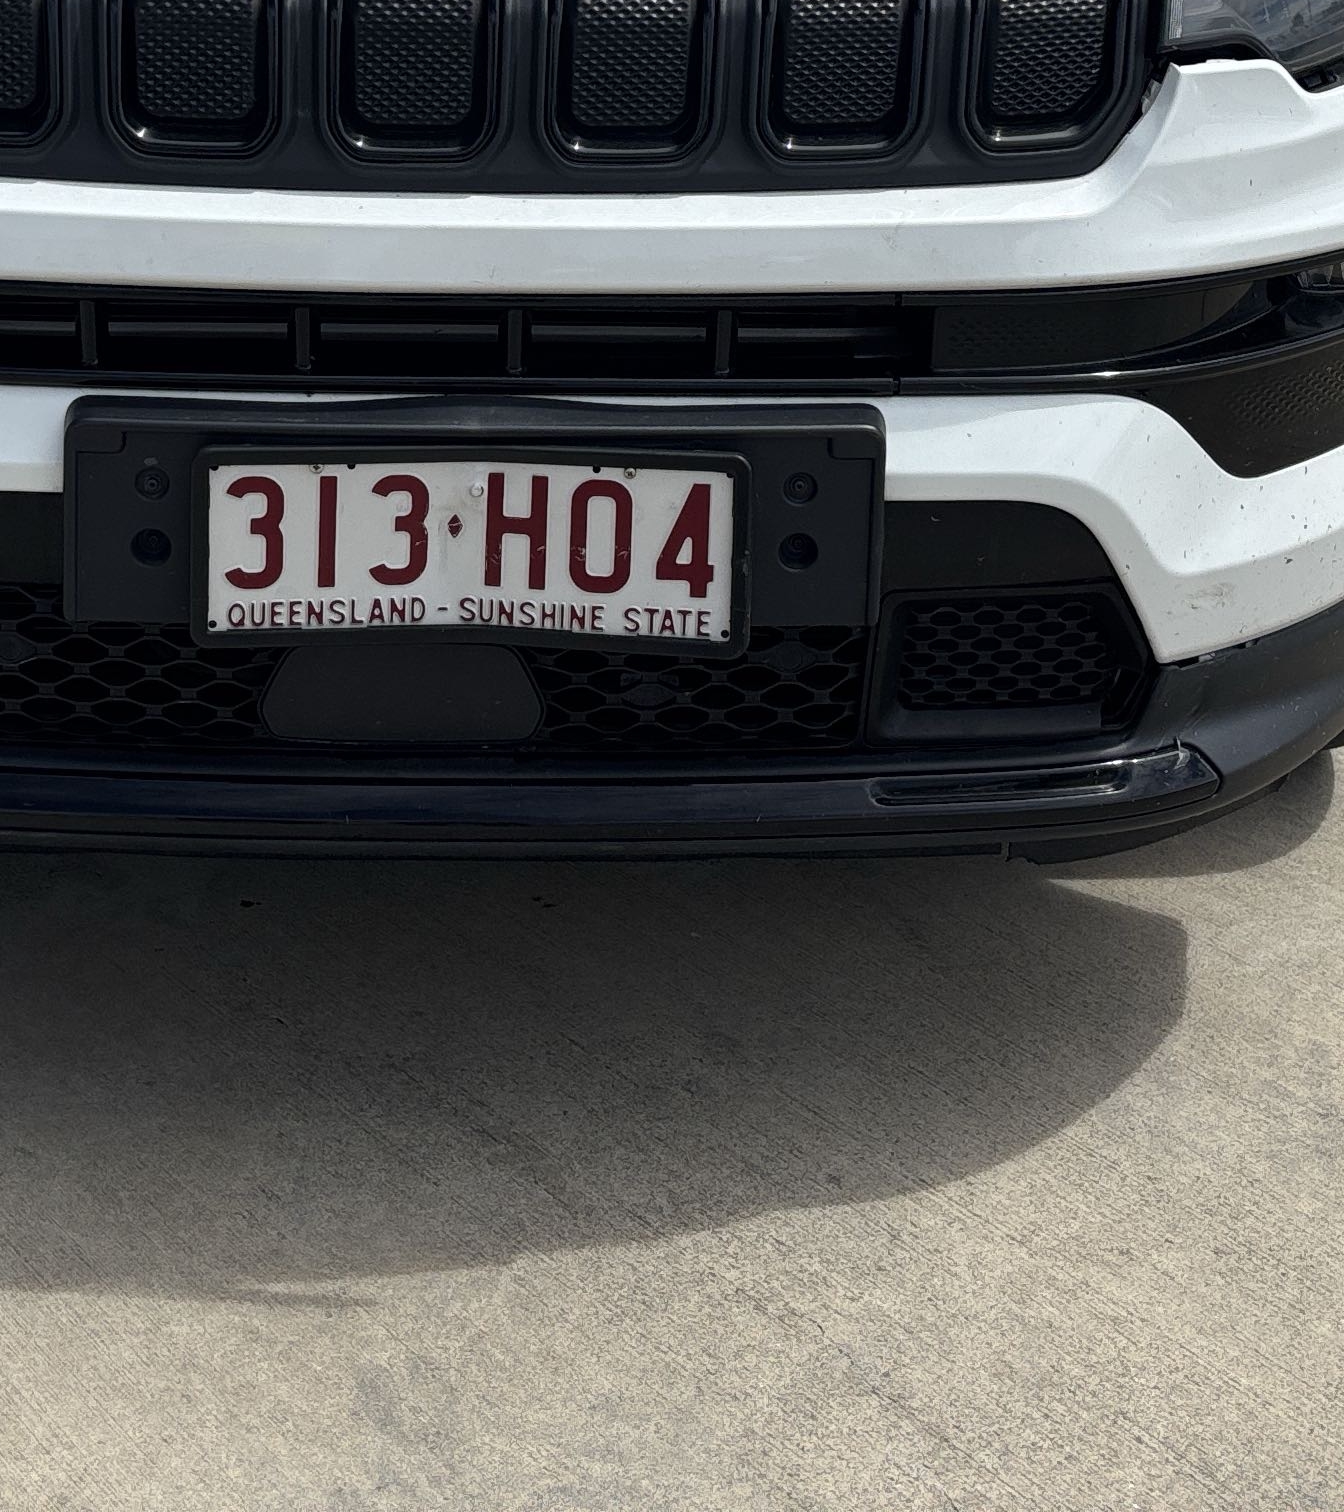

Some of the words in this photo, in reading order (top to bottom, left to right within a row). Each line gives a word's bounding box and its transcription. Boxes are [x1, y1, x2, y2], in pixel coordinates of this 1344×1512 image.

[227, 595, 427, 629] QUEENSLAND
[460, 595, 606, 634] SUNSHINE
[623, 605, 713, 638] STATE
